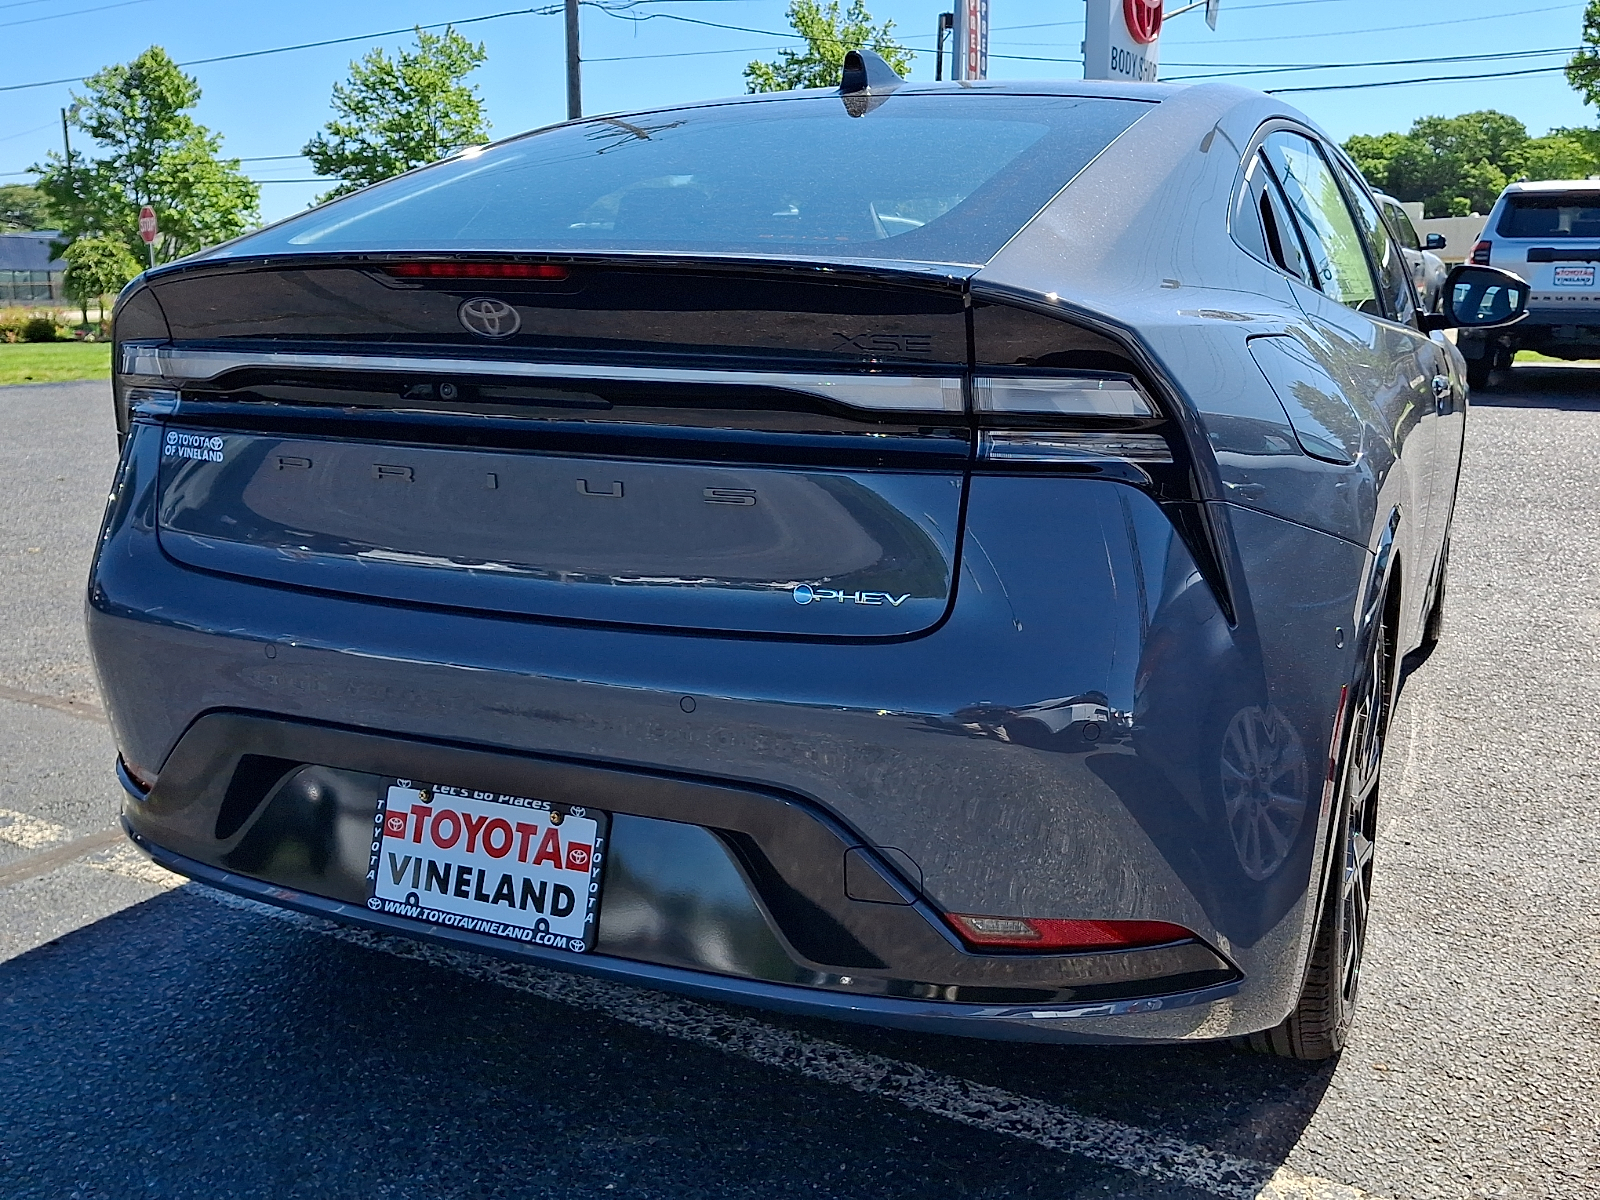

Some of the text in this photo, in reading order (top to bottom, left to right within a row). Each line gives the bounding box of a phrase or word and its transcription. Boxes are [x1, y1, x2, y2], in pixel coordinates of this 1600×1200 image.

[1111, 46, 1138, 78] BODY
[140, 217, 156, 232] STOP
[832, 332, 932, 353] XSE
[165, 445, 223, 462] OF VINELAND
[178, 433, 210, 448] TOYOTA
[276, 455, 757, 507] PRIUS
[813, 589, 911, 607] PHEV
[432, 784, 552, 811] Let's Go Places
[366, 799, 384, 880] TOYOTA
[410, 804, 563, 870] TOYOTA
[388, 852, 576, 918] VINELAND
[585, 837, 603, 924] TOYOTA
[384, 900, 567, 948] WWW.TOYOTAVINELAND.COM
